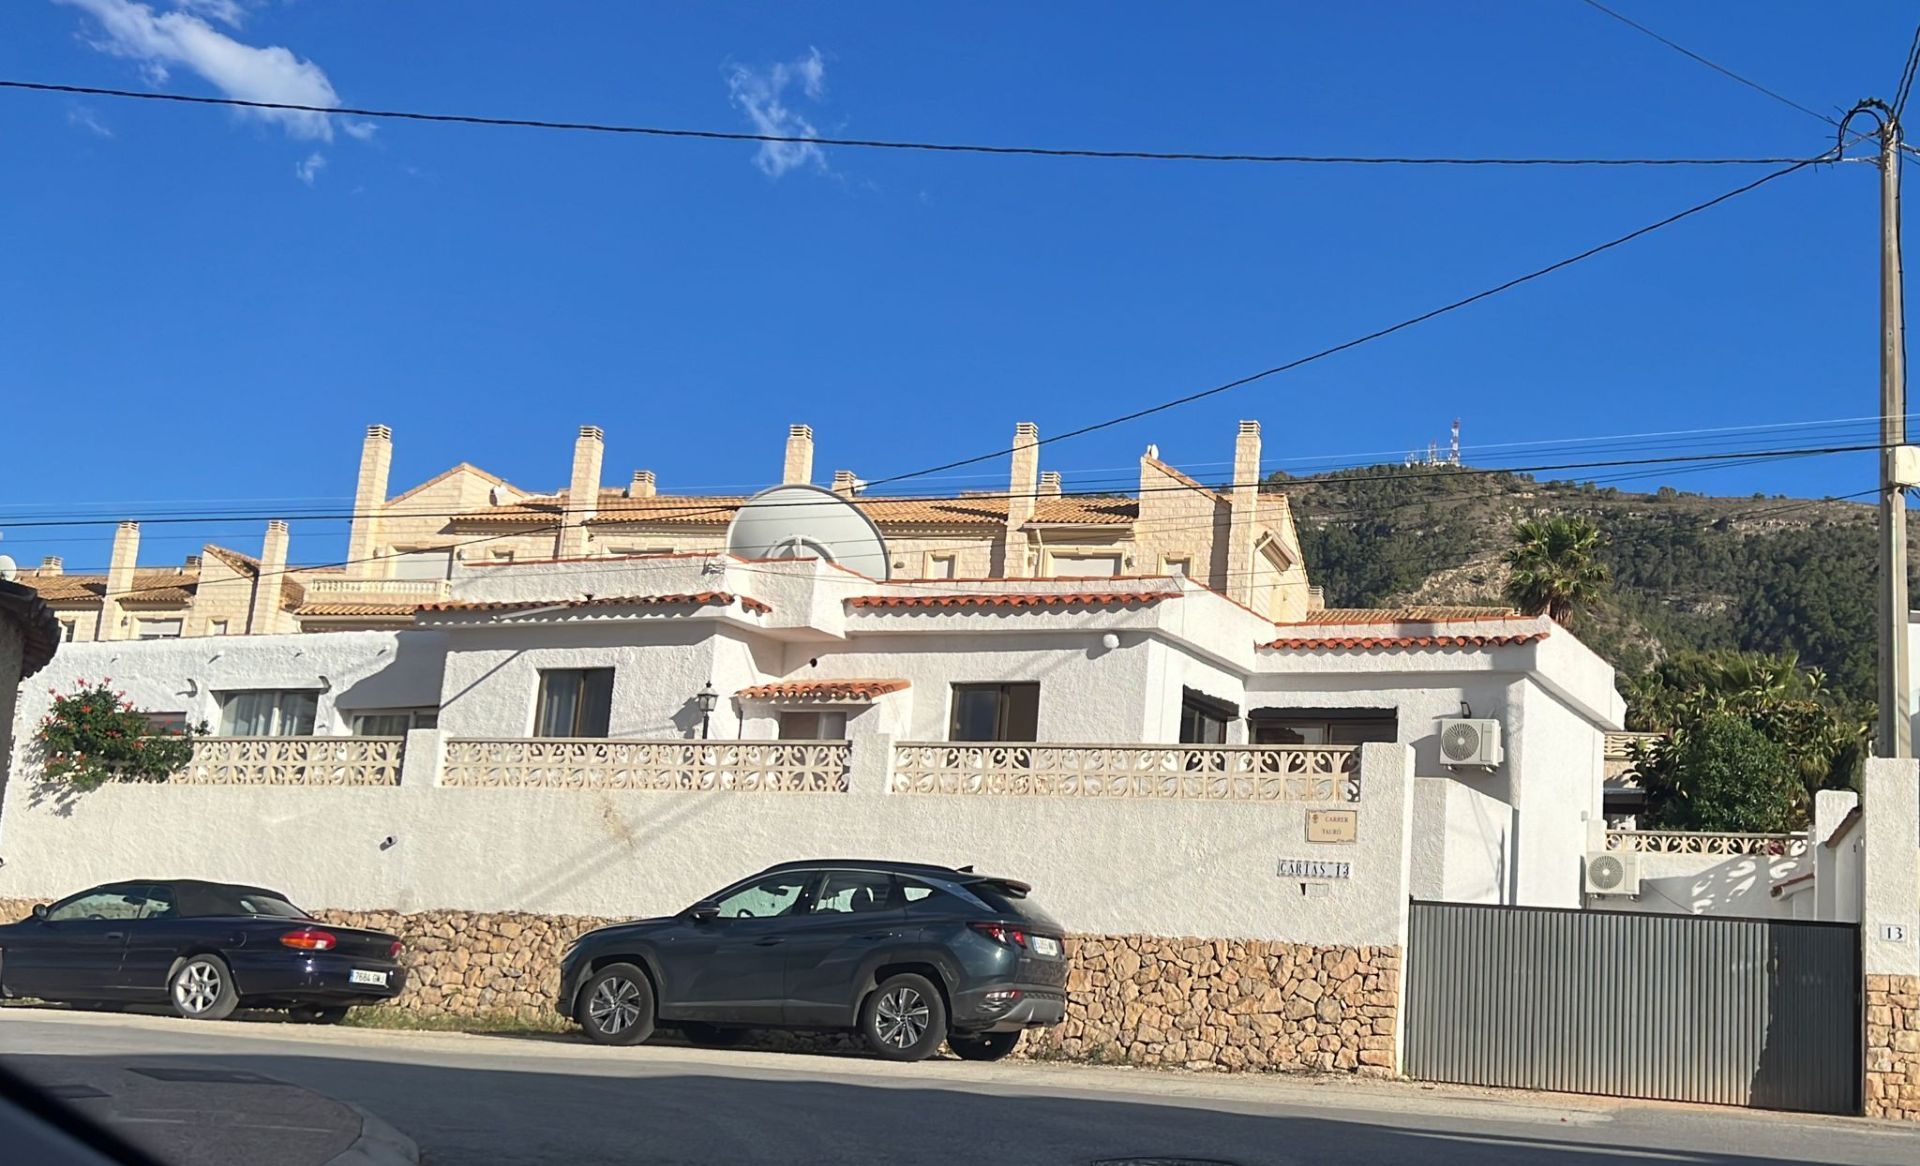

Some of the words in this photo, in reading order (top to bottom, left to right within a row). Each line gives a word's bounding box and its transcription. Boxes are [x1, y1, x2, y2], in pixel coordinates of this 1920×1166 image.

[1280, 862, 1325, 874] CARTAS
[1336, 863, 1349, 876] 13
[1887, 926, 1903, 940] 13
